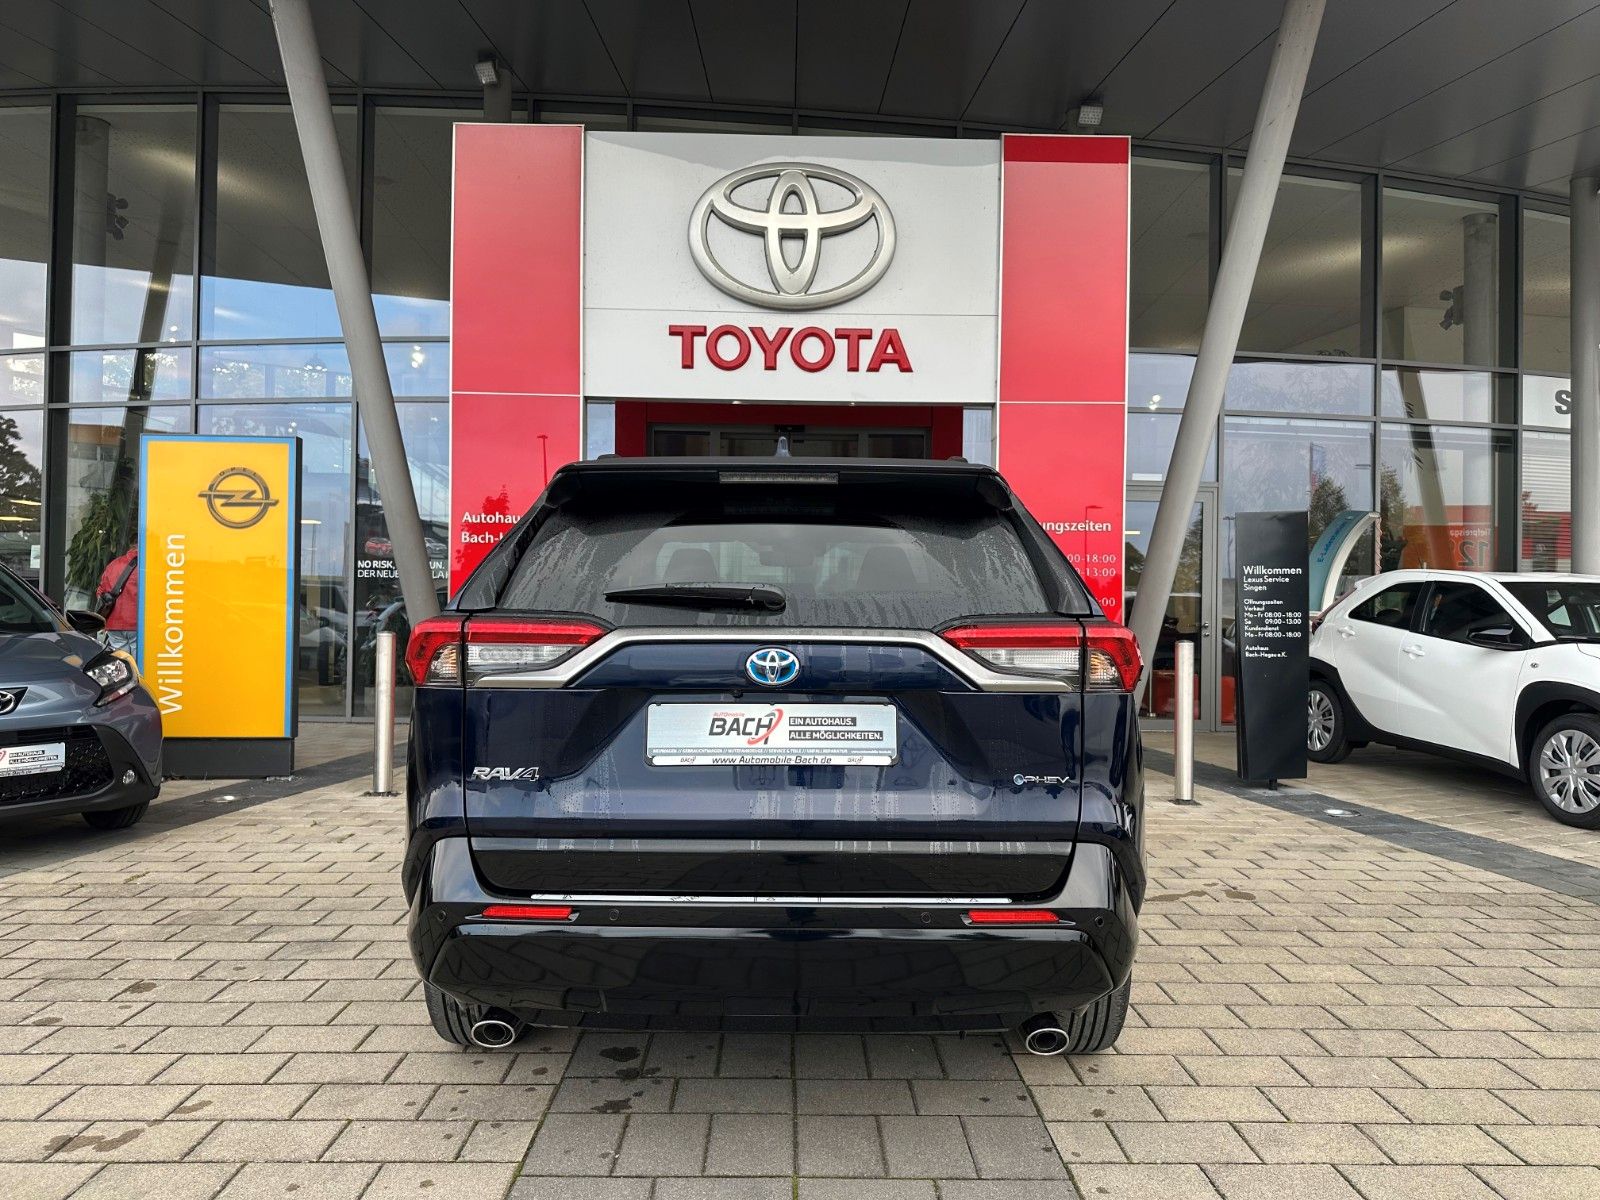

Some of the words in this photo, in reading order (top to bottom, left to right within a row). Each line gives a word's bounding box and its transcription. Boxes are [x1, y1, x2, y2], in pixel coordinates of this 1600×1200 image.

[668, 324, 914, 373] TOYOTA
[219, 466, 258, 477] OPEL
[462, 511, 521, 524] Autohau
[461, 531, 503, 544] Bach-
[357, 560, 371, 569] NO
[373, 560, 396, 571] RISK,
[429, 561, 445, 570] UN.
[1242, 565, 1302, 575] Willkommen
[357, 569, 374, 578] DER
[1243, 575, 1263, 583] Lexus
[1263, 575, 1290, 583] Service
[1243, 583, 1267, 592] Singen
[156, 533, 184, 715] Willkommen
[789, 717, 804, 726] EIN
[805, 717, 855, 726] AUTOHAUS.
[708, 717, 774, 745] BACH
[789, 730, 811, 740] ALLE
[812, 729, 883, 740] MÖGLICHKEITEN.
[471, 766, 540, 781] RAV4
